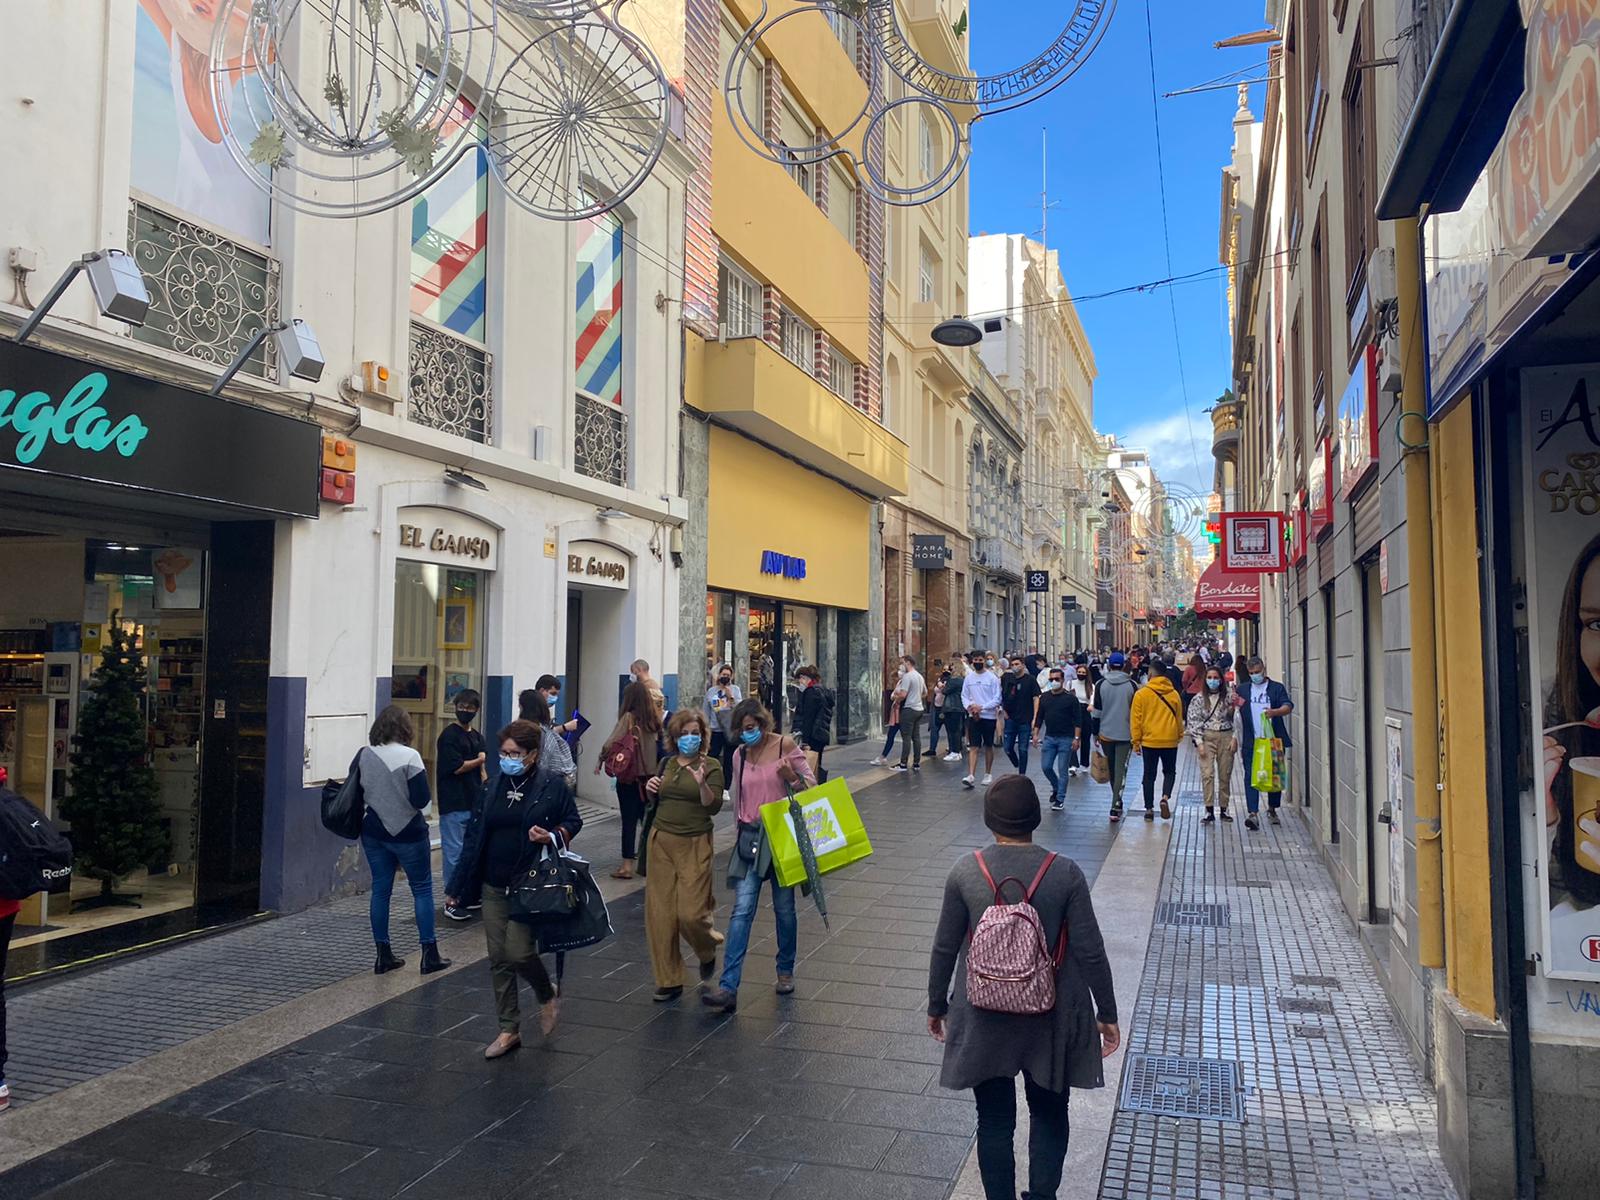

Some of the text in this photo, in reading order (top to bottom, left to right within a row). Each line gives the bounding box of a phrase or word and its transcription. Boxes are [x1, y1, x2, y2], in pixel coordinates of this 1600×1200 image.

[1536, 377, 1600, 451] A
[400, 524, 490, 560] EL GANSO
[567, 554, 625, 582] EL GANSO
